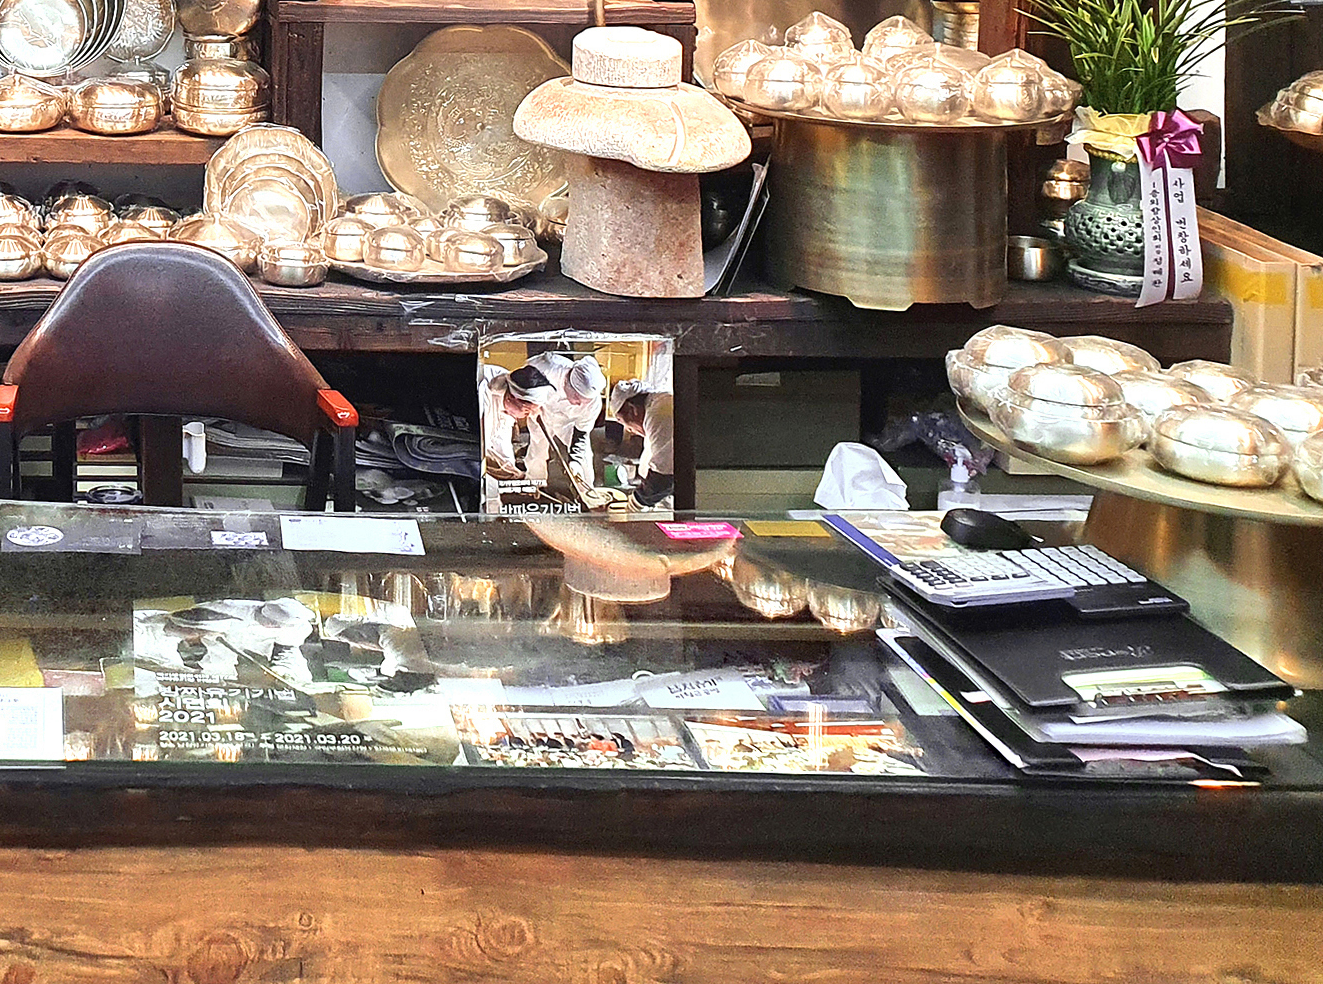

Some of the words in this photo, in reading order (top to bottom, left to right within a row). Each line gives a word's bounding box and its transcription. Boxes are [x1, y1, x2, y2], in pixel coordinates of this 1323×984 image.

[1173, 177, 1185, 204] 사업
[158, 709, 215, 724] 2021
[274, 732, 361, 745] 2021.03.20
